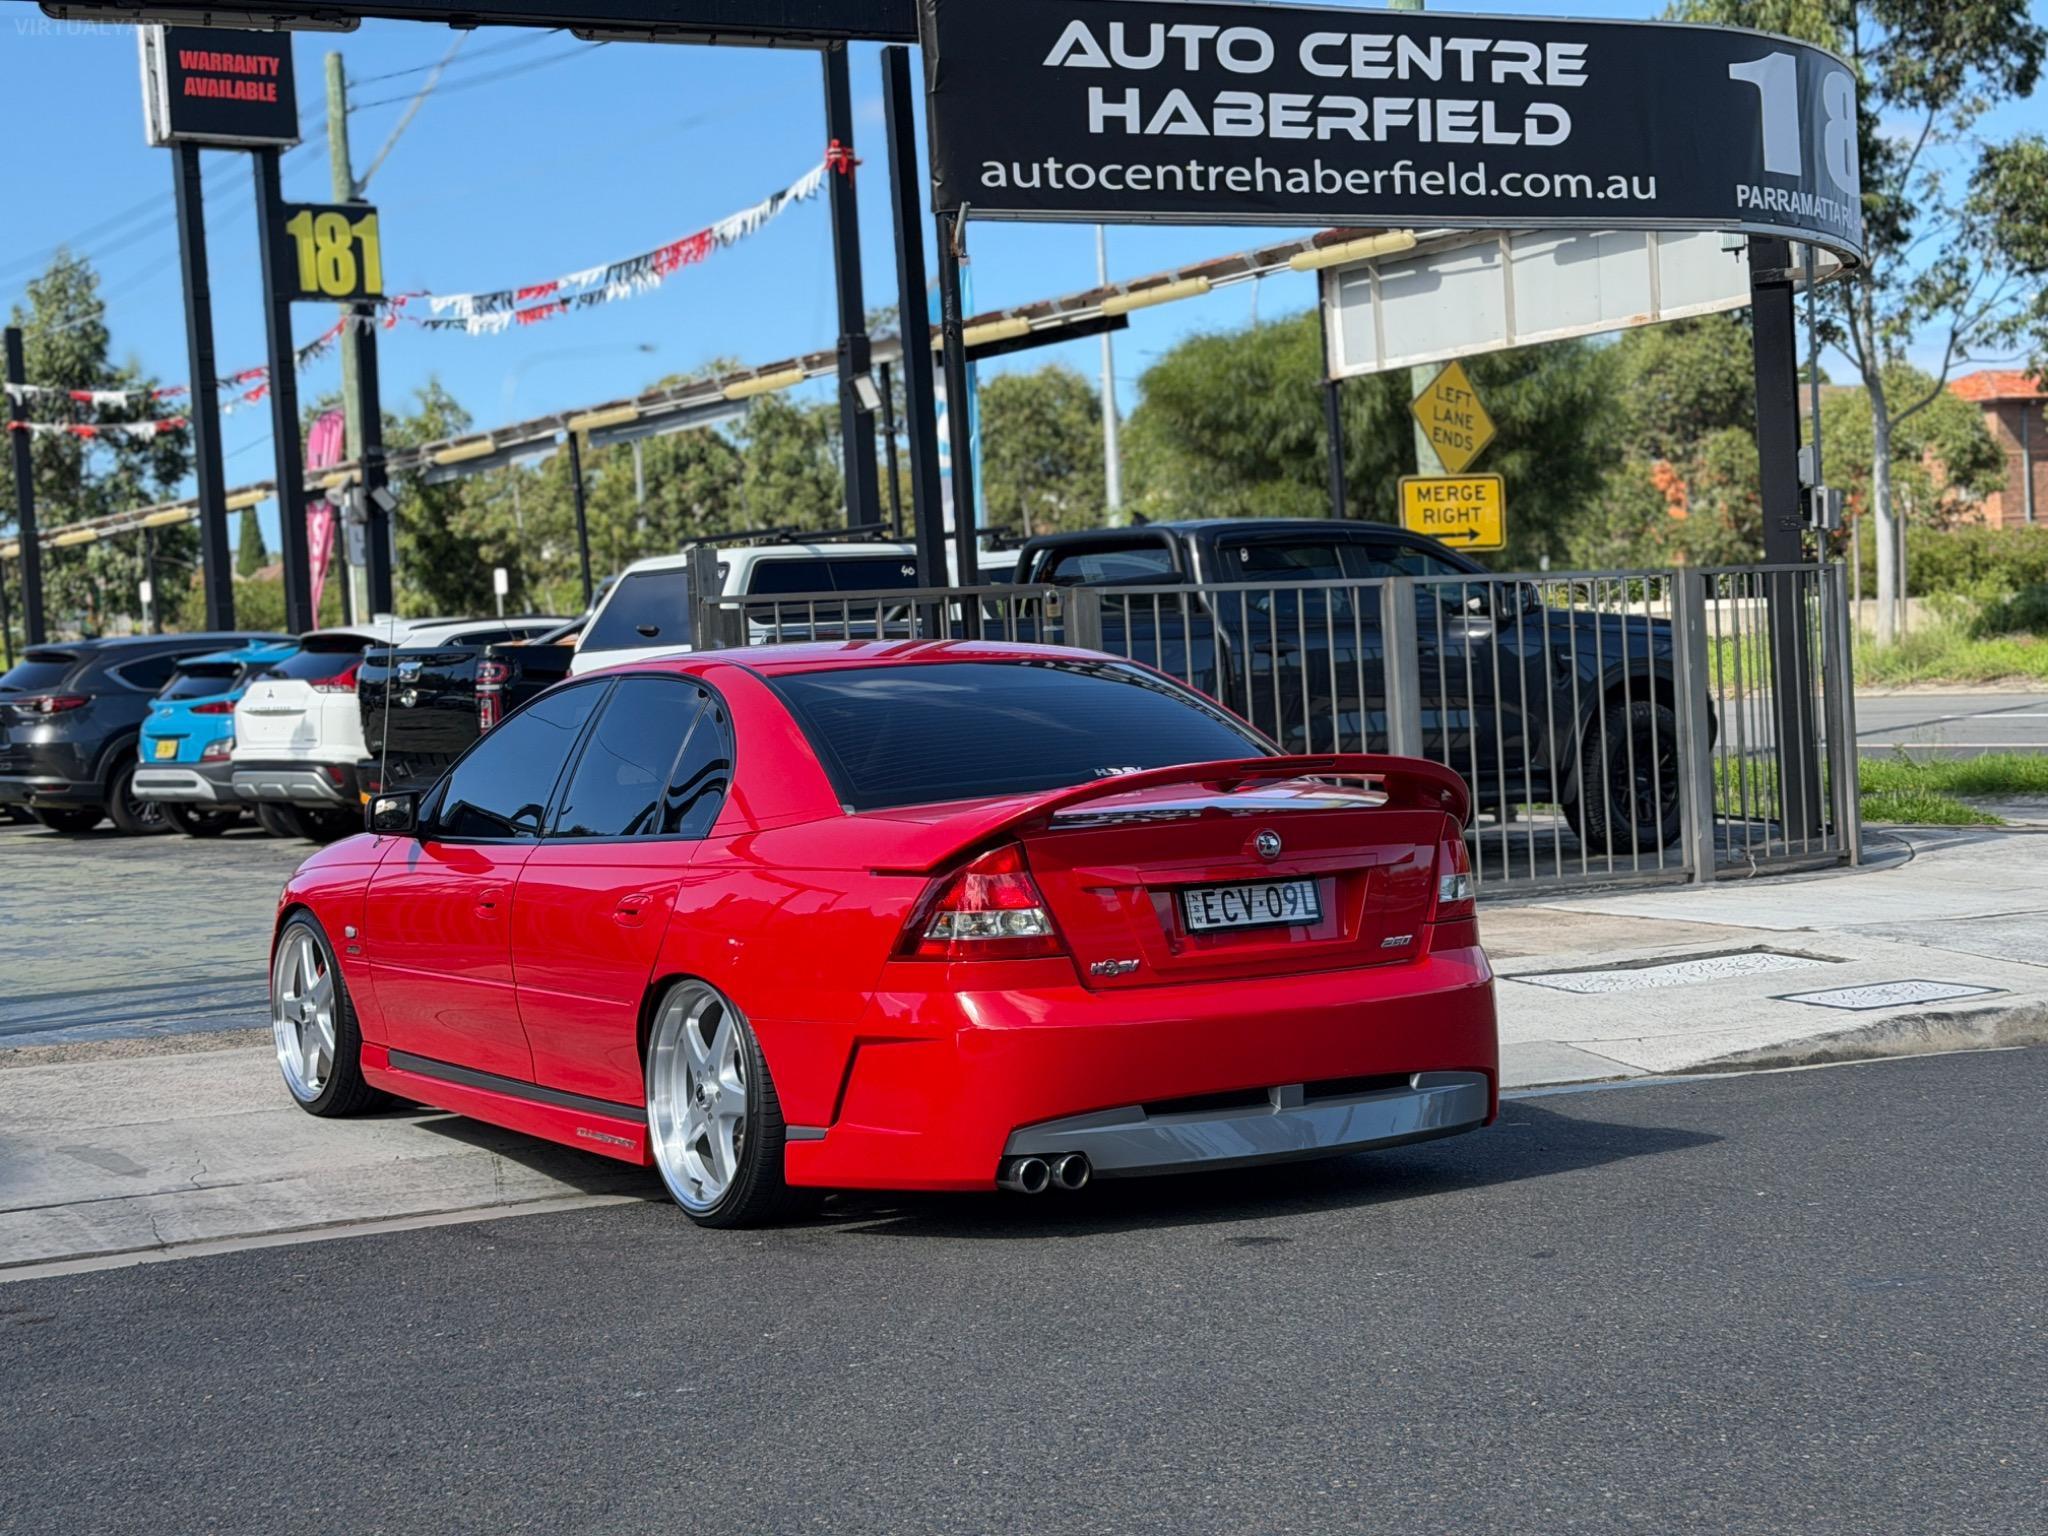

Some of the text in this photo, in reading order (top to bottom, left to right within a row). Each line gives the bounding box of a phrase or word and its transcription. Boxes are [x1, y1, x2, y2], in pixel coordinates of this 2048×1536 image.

[179, 50, 280, 77] WARRANTY
[1042, 19, 1589, 87] AUTO CENTRE
[183, 76, 278, 103] AVAILABLE
[1088, 86, 1573, 146] HABERFIELD
[980, 157, 1658, 200] autocentrehaberfield.com.au
[1736, 184, 1841, 224] PARRAMATTA
[286, 209, 384, 297] 181
[1436, 383, 1472, 408] LEFT
[1434, 405, 1474, 431] LANE
[1432, 426, 1474, 452] ENDS
[1417, 485, 1486, 503] MERGE
[1422, 506, 1482, 524] RIGHT
